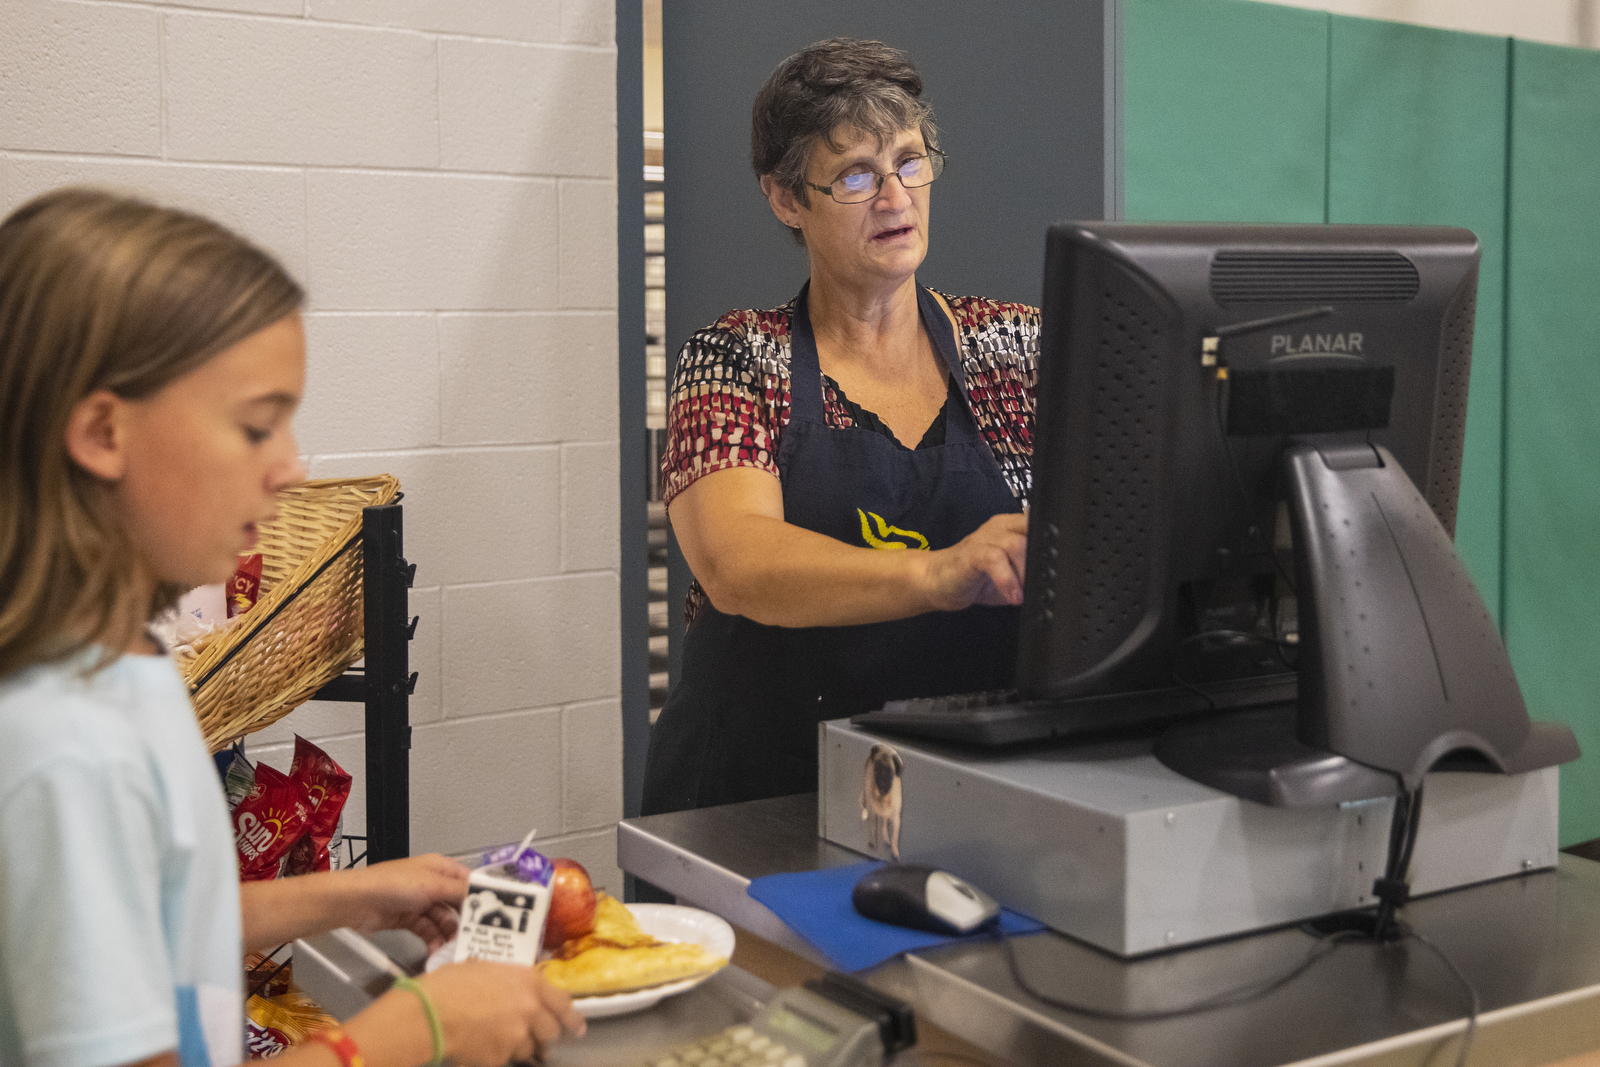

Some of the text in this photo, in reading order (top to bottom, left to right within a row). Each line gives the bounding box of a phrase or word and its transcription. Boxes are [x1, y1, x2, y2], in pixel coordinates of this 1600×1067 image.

[1270, 332, 1364, 354] PLANAR
[234, 576, 255, 593] CY
[235, 811, 273, 852] Sun
